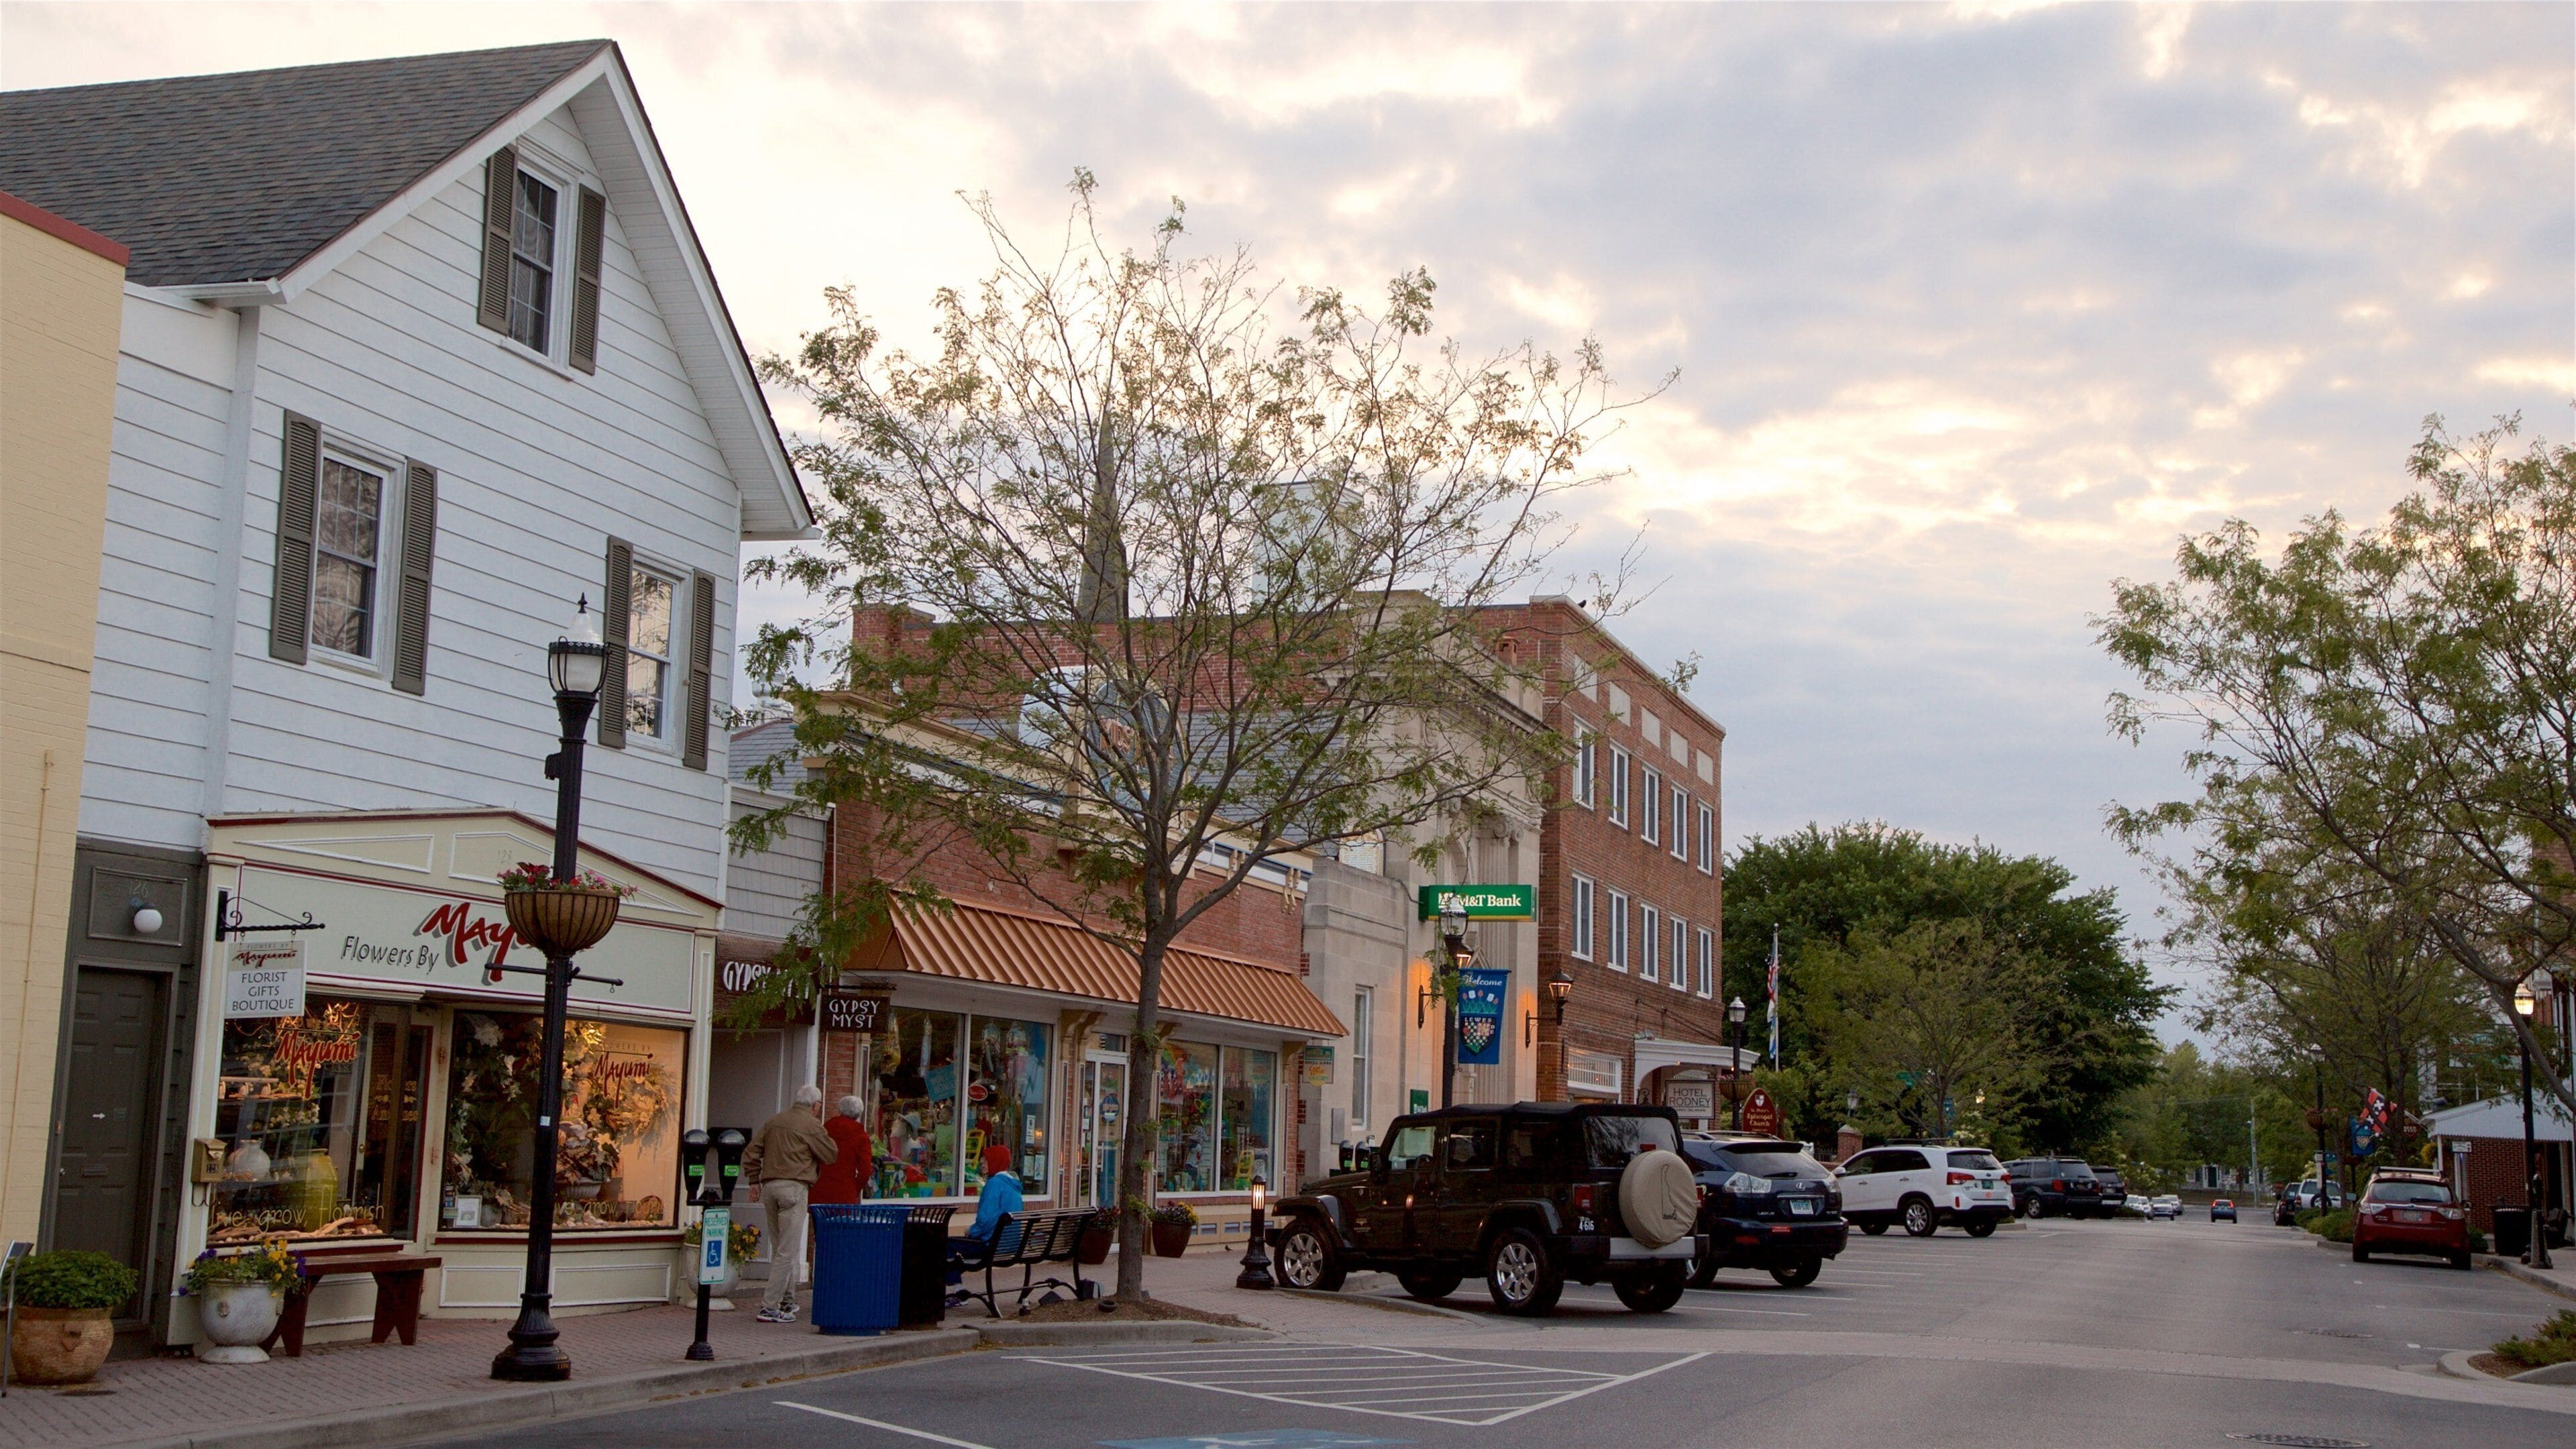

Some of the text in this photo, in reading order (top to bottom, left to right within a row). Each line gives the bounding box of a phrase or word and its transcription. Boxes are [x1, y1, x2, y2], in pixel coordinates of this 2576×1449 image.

[1487, 894, 1521, 906] Bank
[231, 950, 297, 968] Mayumi
[341, 935, 414, 967] Flowers
[417, 945, 439, 975] By
[241, 971, 287, 983] FLORIST
[248, 985, 280, 997] GIFTS
[232, 999, 294, 1011] BOUTIQUE
[829, 999, 880, 1014] GYPSY
[832, 1014, 874, 1028] MYST
[276, 1028, 360, 1100] Mayumi
[594, 1051, 653, 1109] Mayumi
[1674, 1088, 1707, 1097] HOTEL
[1670, 1097, 1711, 1106] RODNEY
[258, 1208, 308, 1234] grow,
[706, 1217, 728, 1227] RESERVED
[707, 1228, 724, 1238] PARKING
